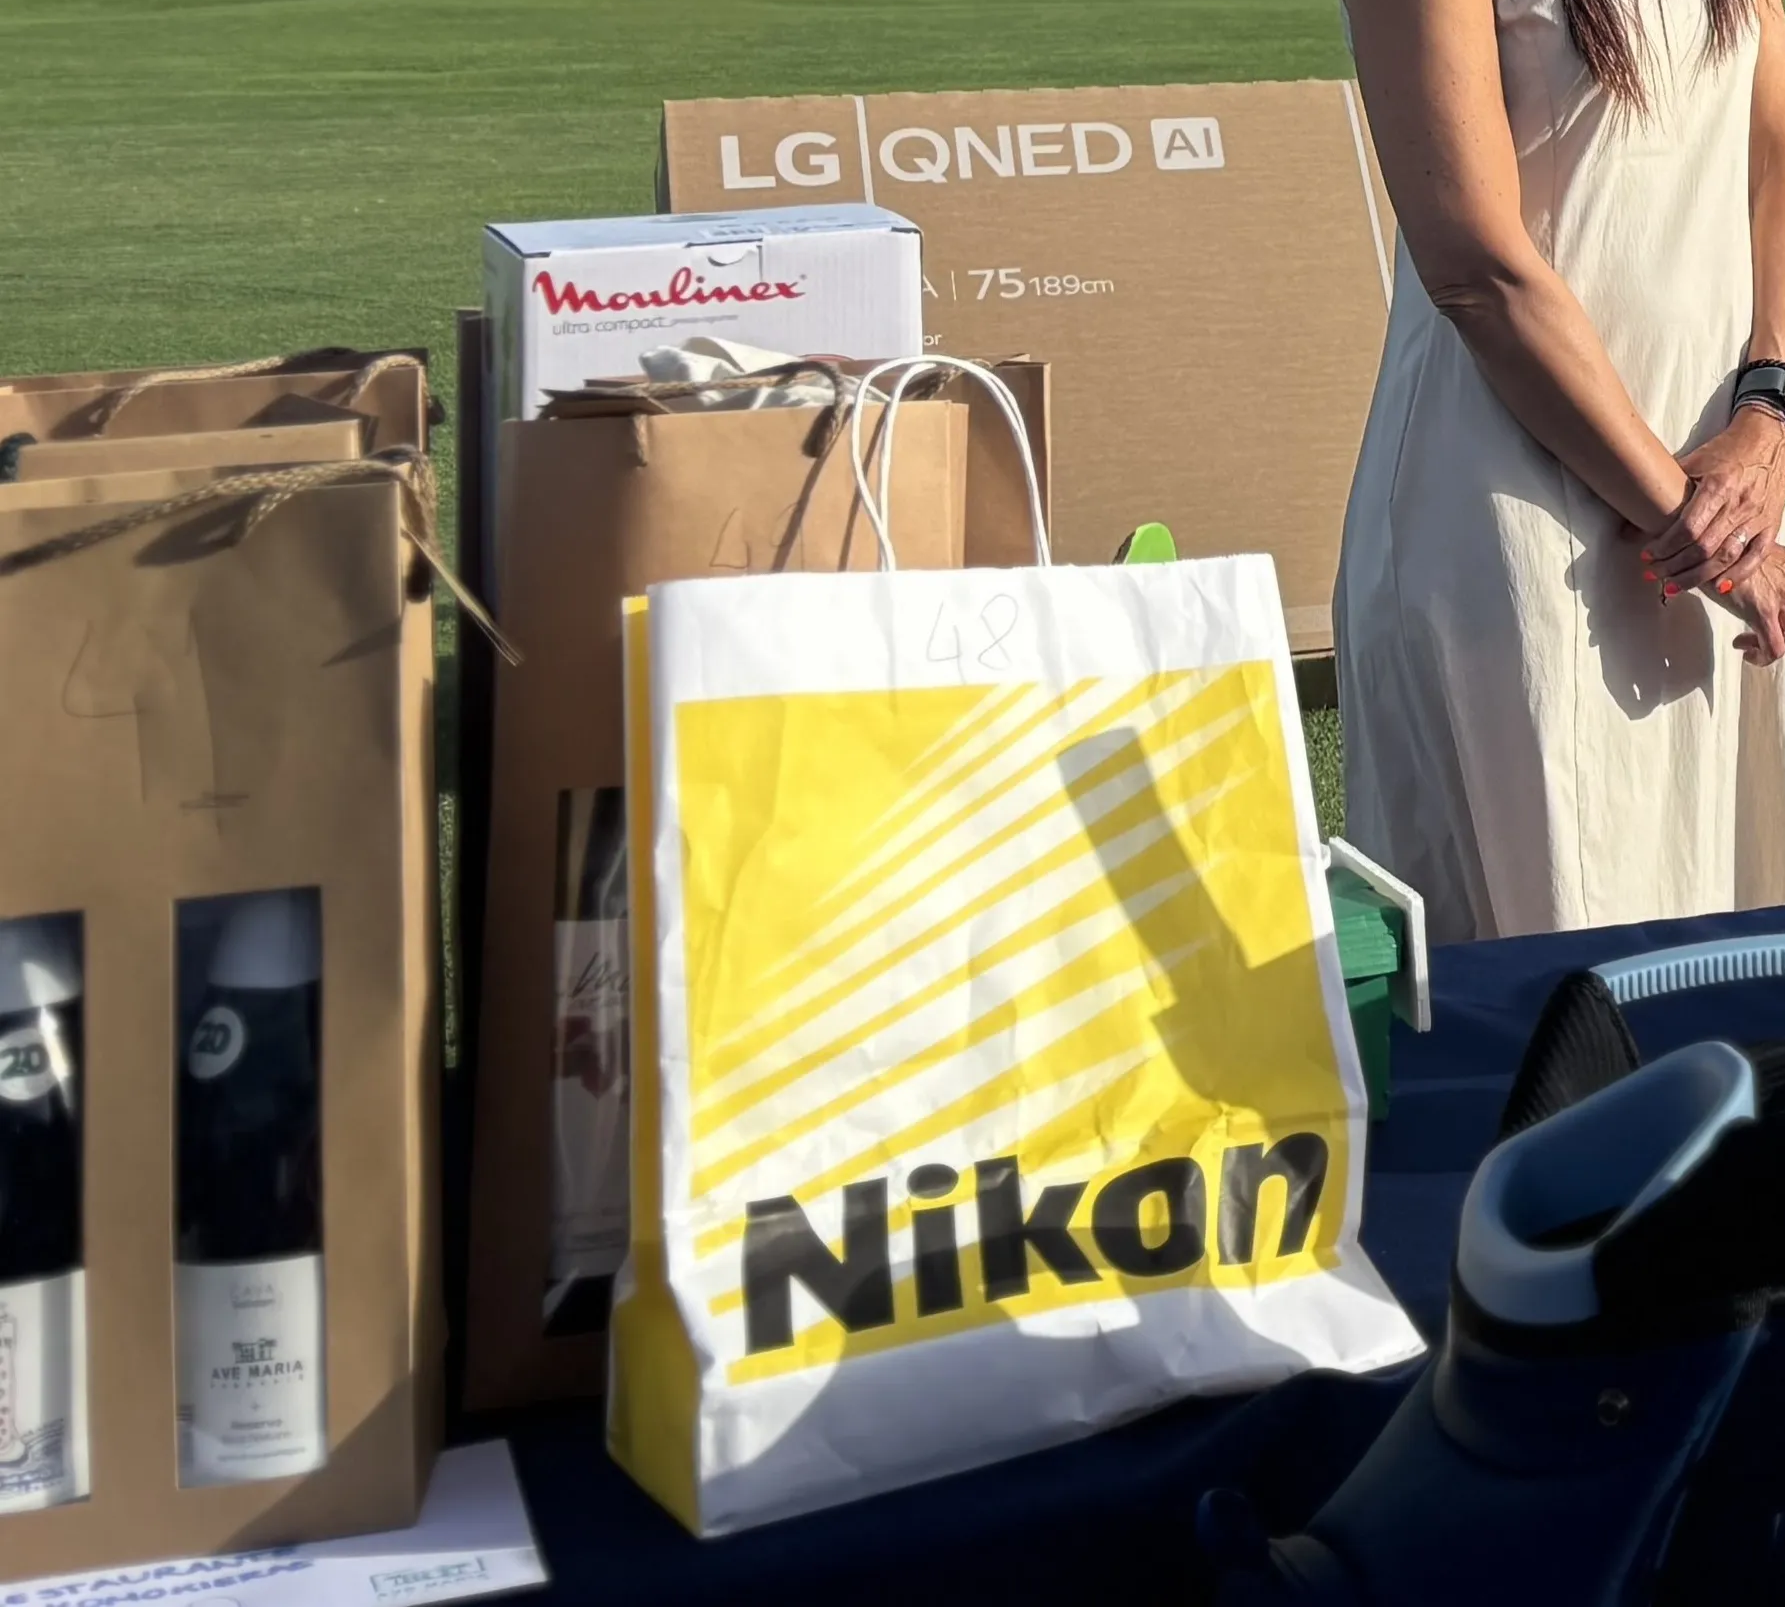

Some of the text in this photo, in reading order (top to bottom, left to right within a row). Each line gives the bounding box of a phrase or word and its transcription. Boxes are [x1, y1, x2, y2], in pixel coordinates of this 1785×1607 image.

[719, 121, 1215, 190] LG QNED AI
[531, 265, 807, 316] Moulinex
[967, 267, 1027, 301] 75
[1028, 274, 1114, 297] 189cm
[926, 592, 1020, 686] 48
[194, 1022, 232, 1056] 20
[0, 1043, 50, 1080] 20
[743, 1131, 1331, 1357] Nikon
[211, 1366, 241, 1382] AVE
[248, 1359, 304, 1379] MARIA
